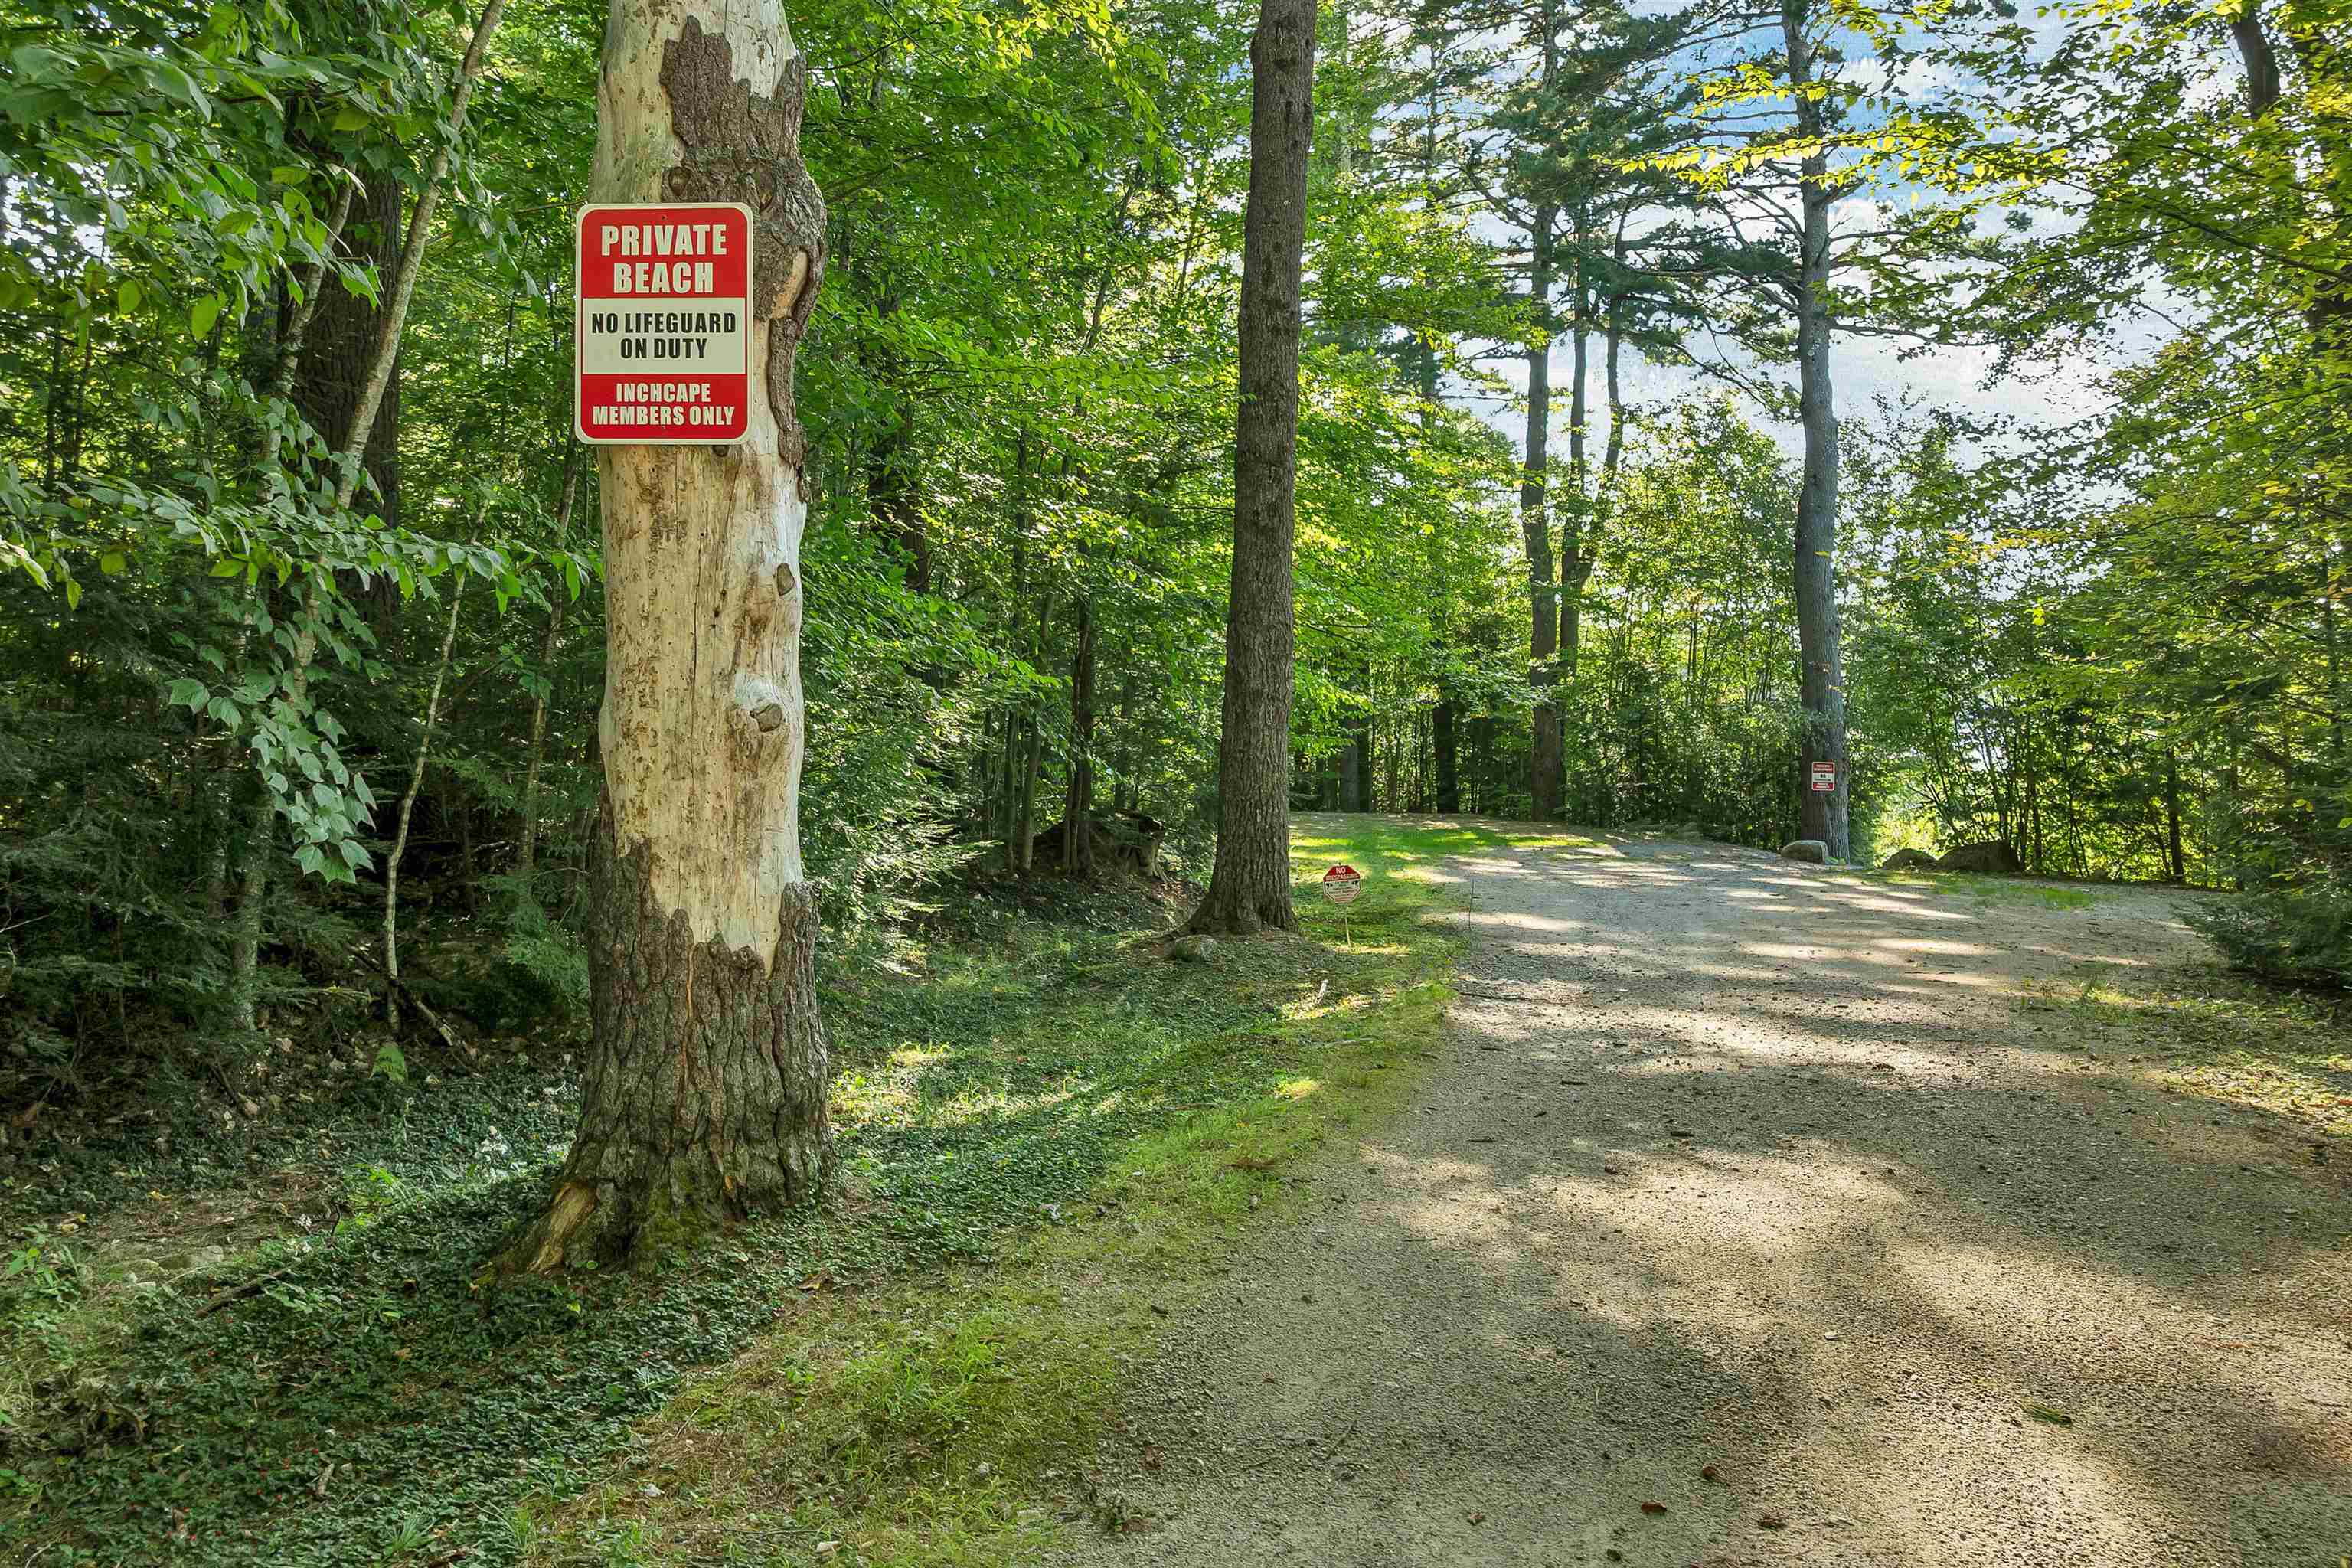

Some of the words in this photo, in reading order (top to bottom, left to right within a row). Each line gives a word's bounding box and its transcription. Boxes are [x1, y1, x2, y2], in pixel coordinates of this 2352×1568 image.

[601, 224, 727, 256] PRIVATE
[613, 262, 714, 293] BEACH
[592, 312, 619, 334] NO
[625, 312, 737, 333] LIFEGUARD
[620, 338, 647, 359] ON
[654, 338, 707, 358] DUTY
[616, 383, 710, 403] INCHCAPE
[593, 406, 685, 426] MEMBERS
[690, 406, 735, 426] ONLY
